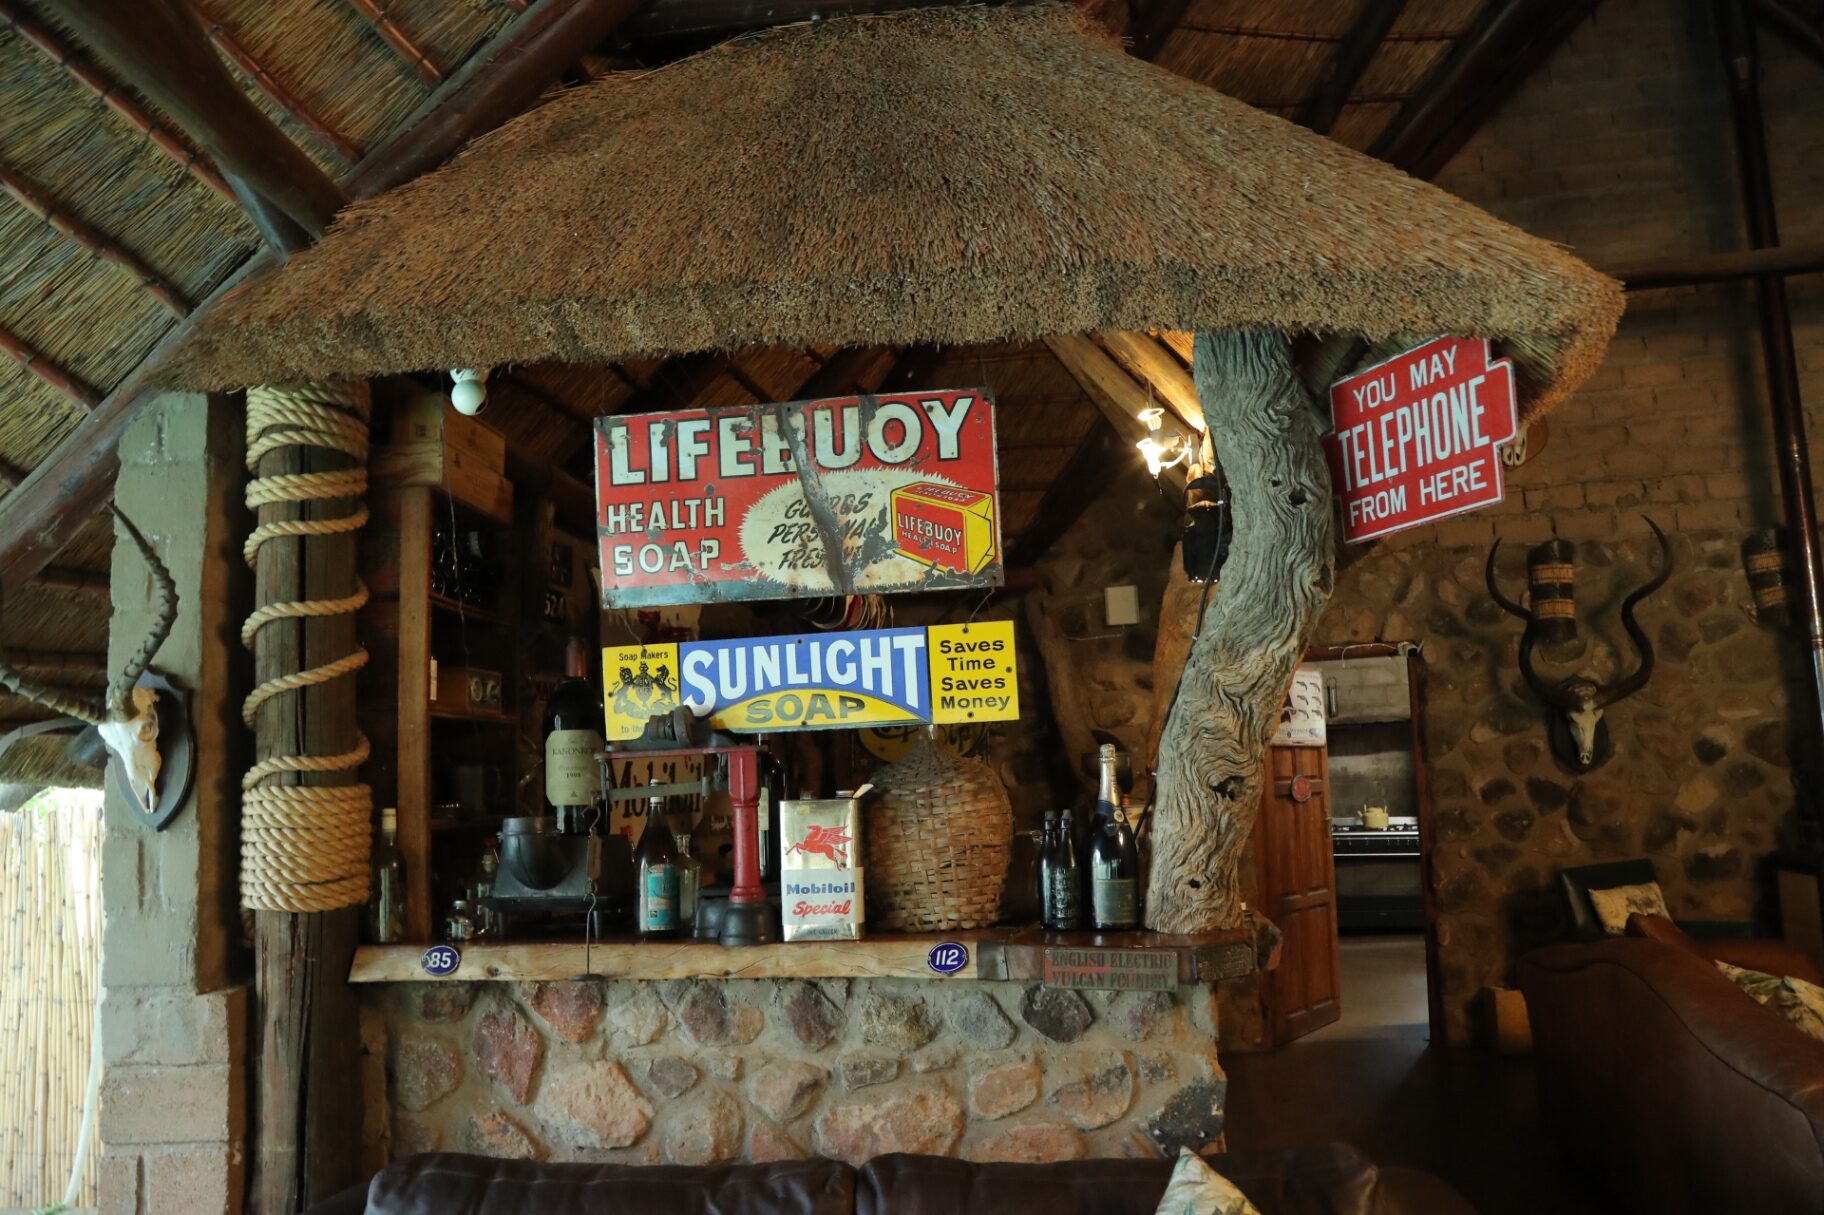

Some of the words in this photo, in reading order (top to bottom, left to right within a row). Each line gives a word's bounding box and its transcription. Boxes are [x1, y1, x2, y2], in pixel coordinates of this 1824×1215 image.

[1353, 372, 1396, 413] YOU
[1409, 345, 1457, 391] MAY
[609, 397, 974, 486] LIFEBUOY
[1338, 374, 1490, 492] TELEPHONE
[1350, 485, 1407, 527] FROM
[1420, 459, 1487, 505] HERE
[607, 496, 725, 534] HEALTH
[897, 512, 962, 546] LIFEBUOY
[936, 542, 957, 553] SOAP
[614, 538, 719, 576] SOAP
[940, 639, 1005, 654] Saves
[619, 652, 638, 662] Soap
[640, 651, 669, 660] Makers
[946, 657, 996, 671] Time
[682, 633, 926, 717] SUNLIGHT
[941, 677, 1006, 691] Saves
[746, 692, 866, 723] SOAP
[941, 695, 1011, 711] Money
[786, 882, 855, 895] Mobiloil
[792, 900, 852, 918] Special
[430, 952, 452, 968] 85
[936, 949, 958, 965] 112
[1052, 951, 1105, 967] ENGLISH
[1110, 953, 1172, 969] ELECTRIC
[1052, 971, 1105, 987] VULCAN
